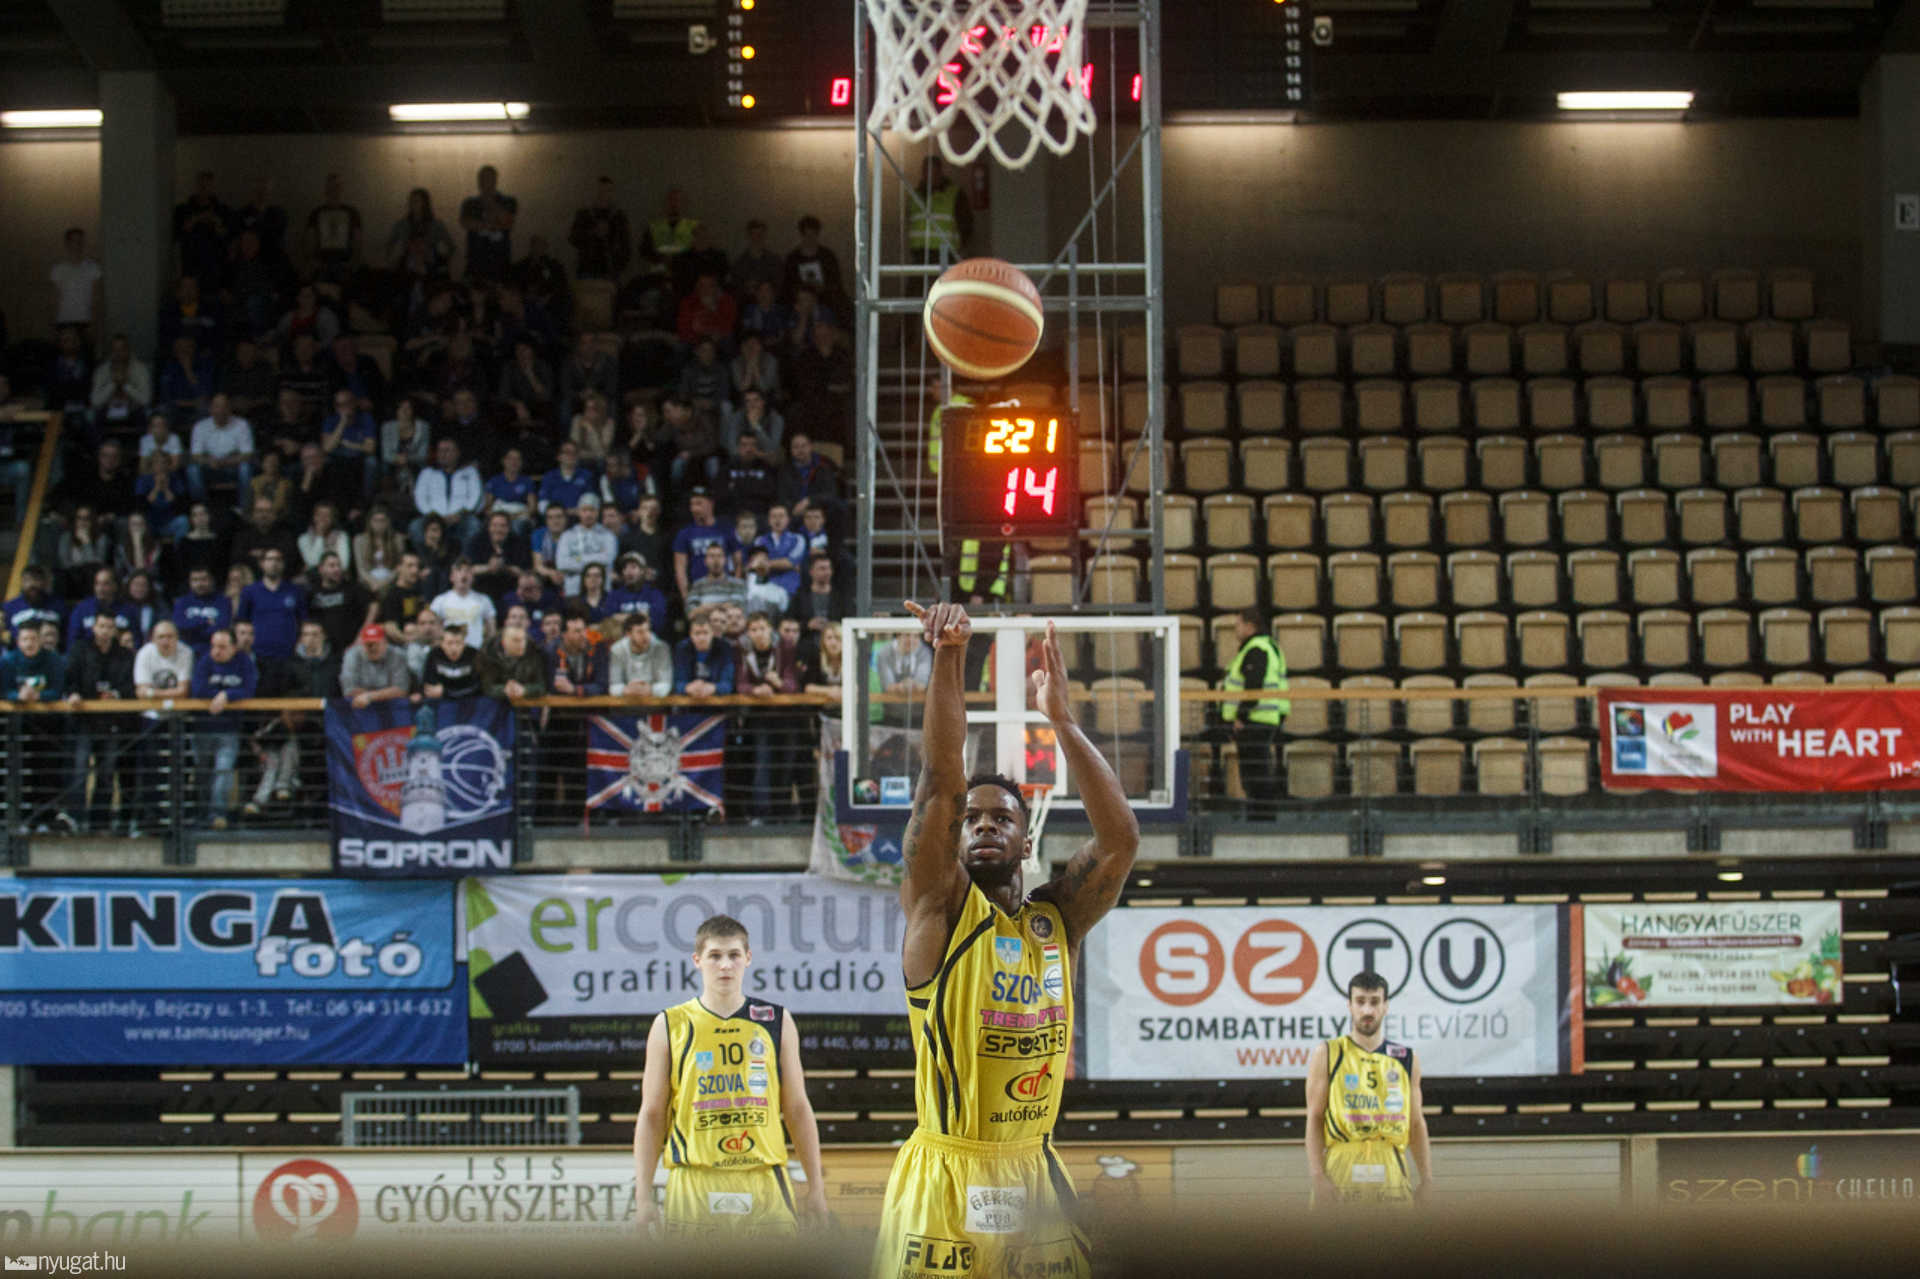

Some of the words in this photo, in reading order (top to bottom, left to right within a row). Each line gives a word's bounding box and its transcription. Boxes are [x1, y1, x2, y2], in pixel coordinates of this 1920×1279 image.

[1004, 467, 1057, 515] 14
[1729, 703, 1795, 724] PLAY
[1730, 728, 1773, 743] WITH
[1777, 728, 1902, 757] HEART
[338, 838, 512, 869] SOPRON
[0, 889, 338, 953] KINGA
[255, 931, 423, 978] fotó
[752, 959, 885, 993] stúdió
[980, 1009, 1037, 1028] TREND
[1139, 1015, 1353, 1041] SZOMBATHELY
[1385, 1007, 1508, 1040] ELEVÍZIÓ
[718, 1042, 744, 1066] 10
[698, 1073, 745, 1095] SZOVA
[1366, 1071, 1378, 1089] 5
[466, 1156, 565, 1181] ISIS
